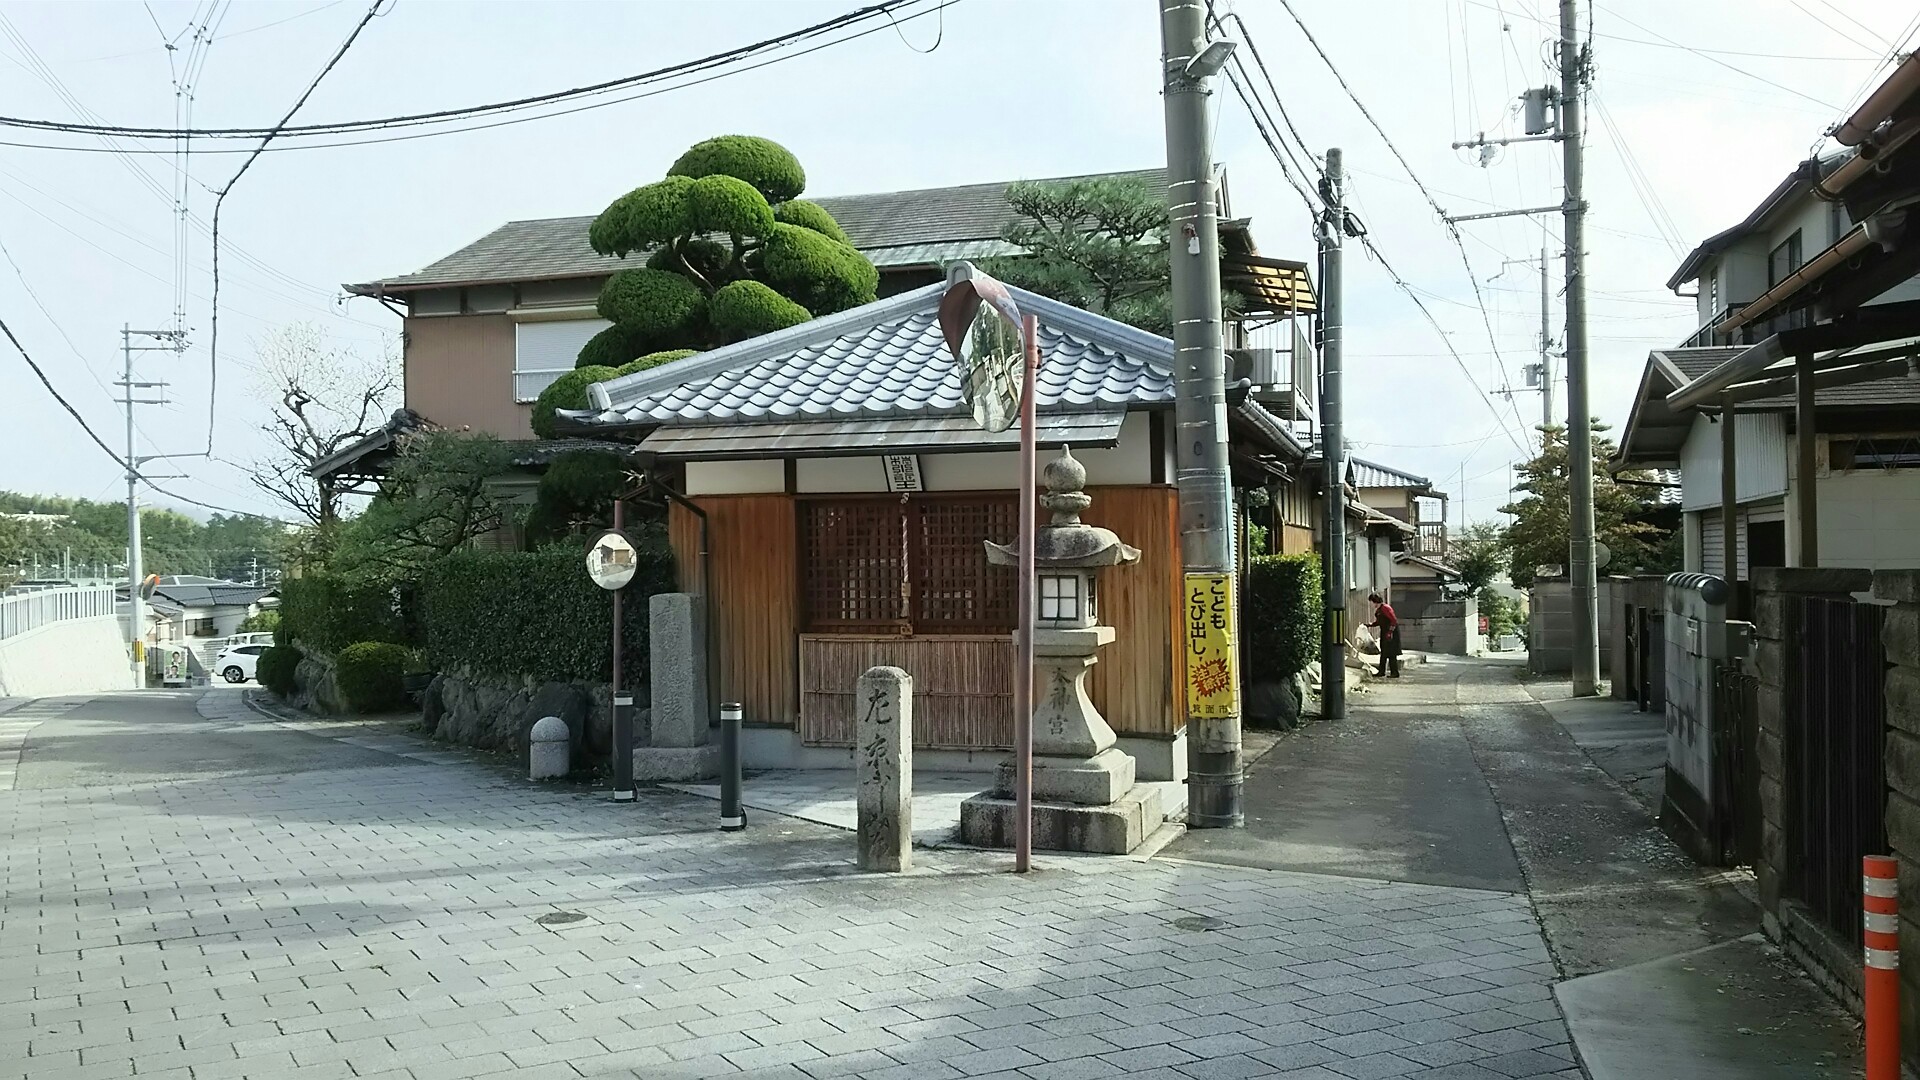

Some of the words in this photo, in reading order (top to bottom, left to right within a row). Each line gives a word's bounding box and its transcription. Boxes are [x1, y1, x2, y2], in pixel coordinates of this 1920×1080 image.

[1190, 588, 1206, 655] とび出し
[1210, 580, 1226, 629] こども
[1192, 704, 1228, 714] 箕面市
